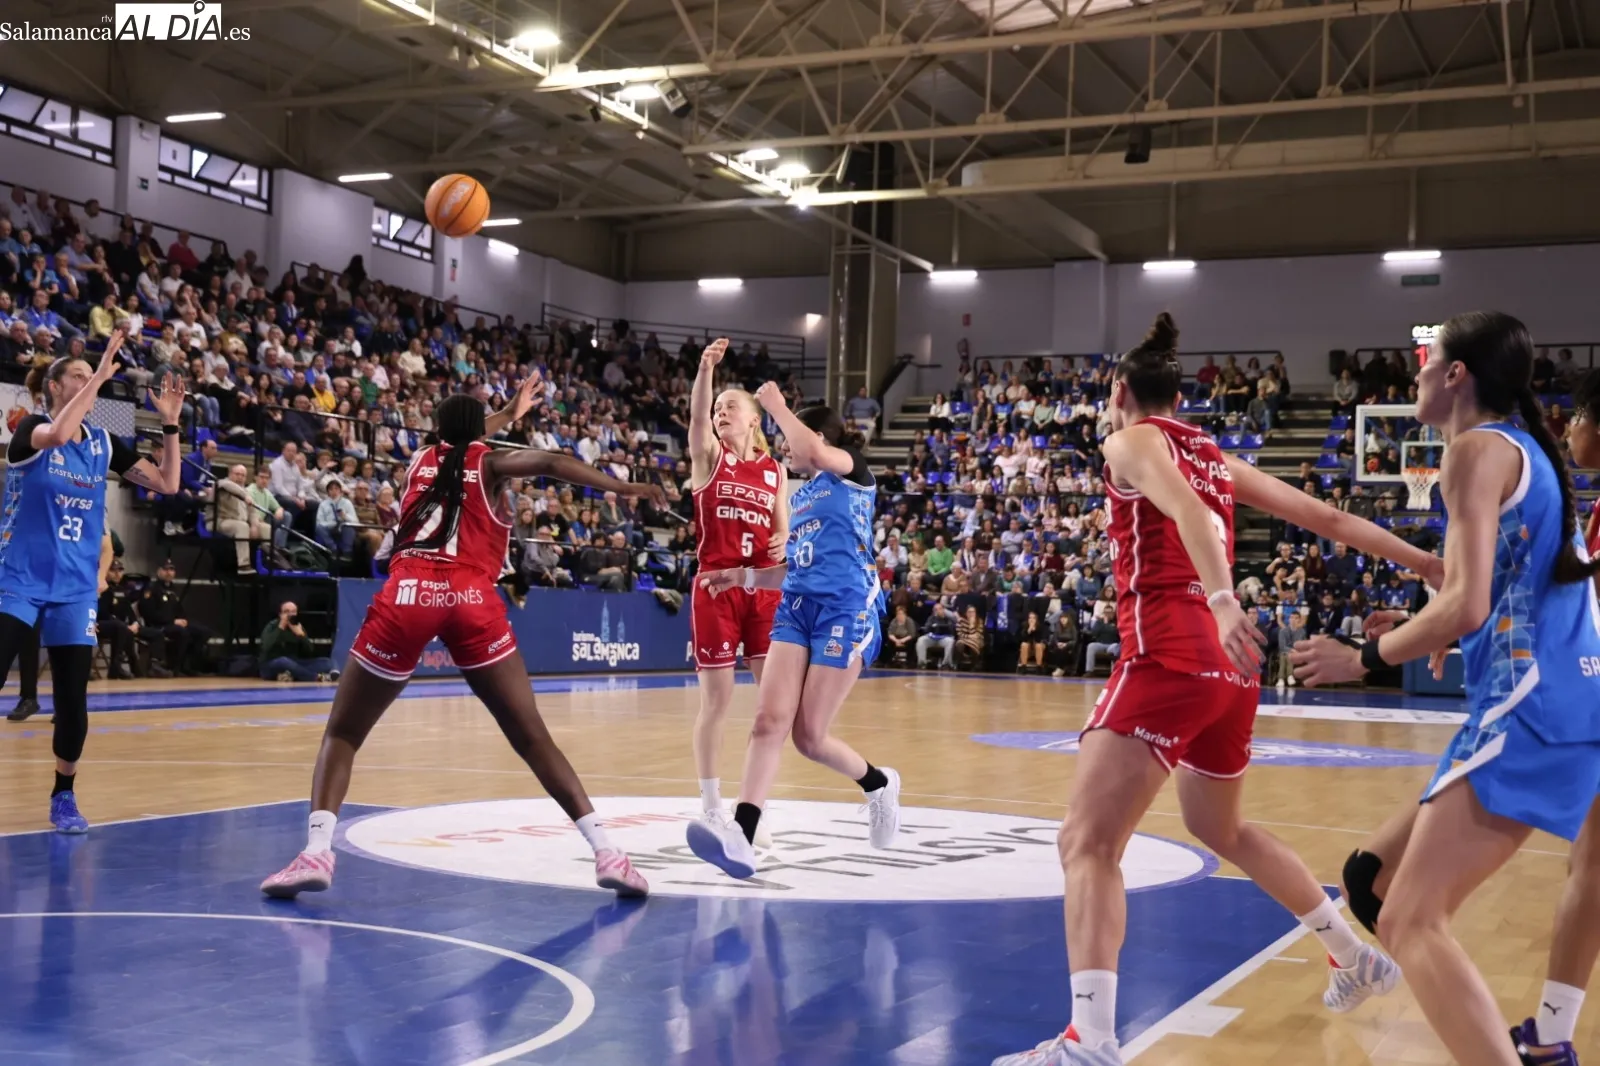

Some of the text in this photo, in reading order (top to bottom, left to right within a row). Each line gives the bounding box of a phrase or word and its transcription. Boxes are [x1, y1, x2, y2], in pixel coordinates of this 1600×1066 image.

[48, 466, 83, 481] CASTILLA
[721, 484, 769, 504] SPAR
[716, 505, 771, 528] GIRON
[58, 514, 83, 542] 23
[741, 532, 754, 557] 5
[418, 586, 484, 608] GIRONÈS
